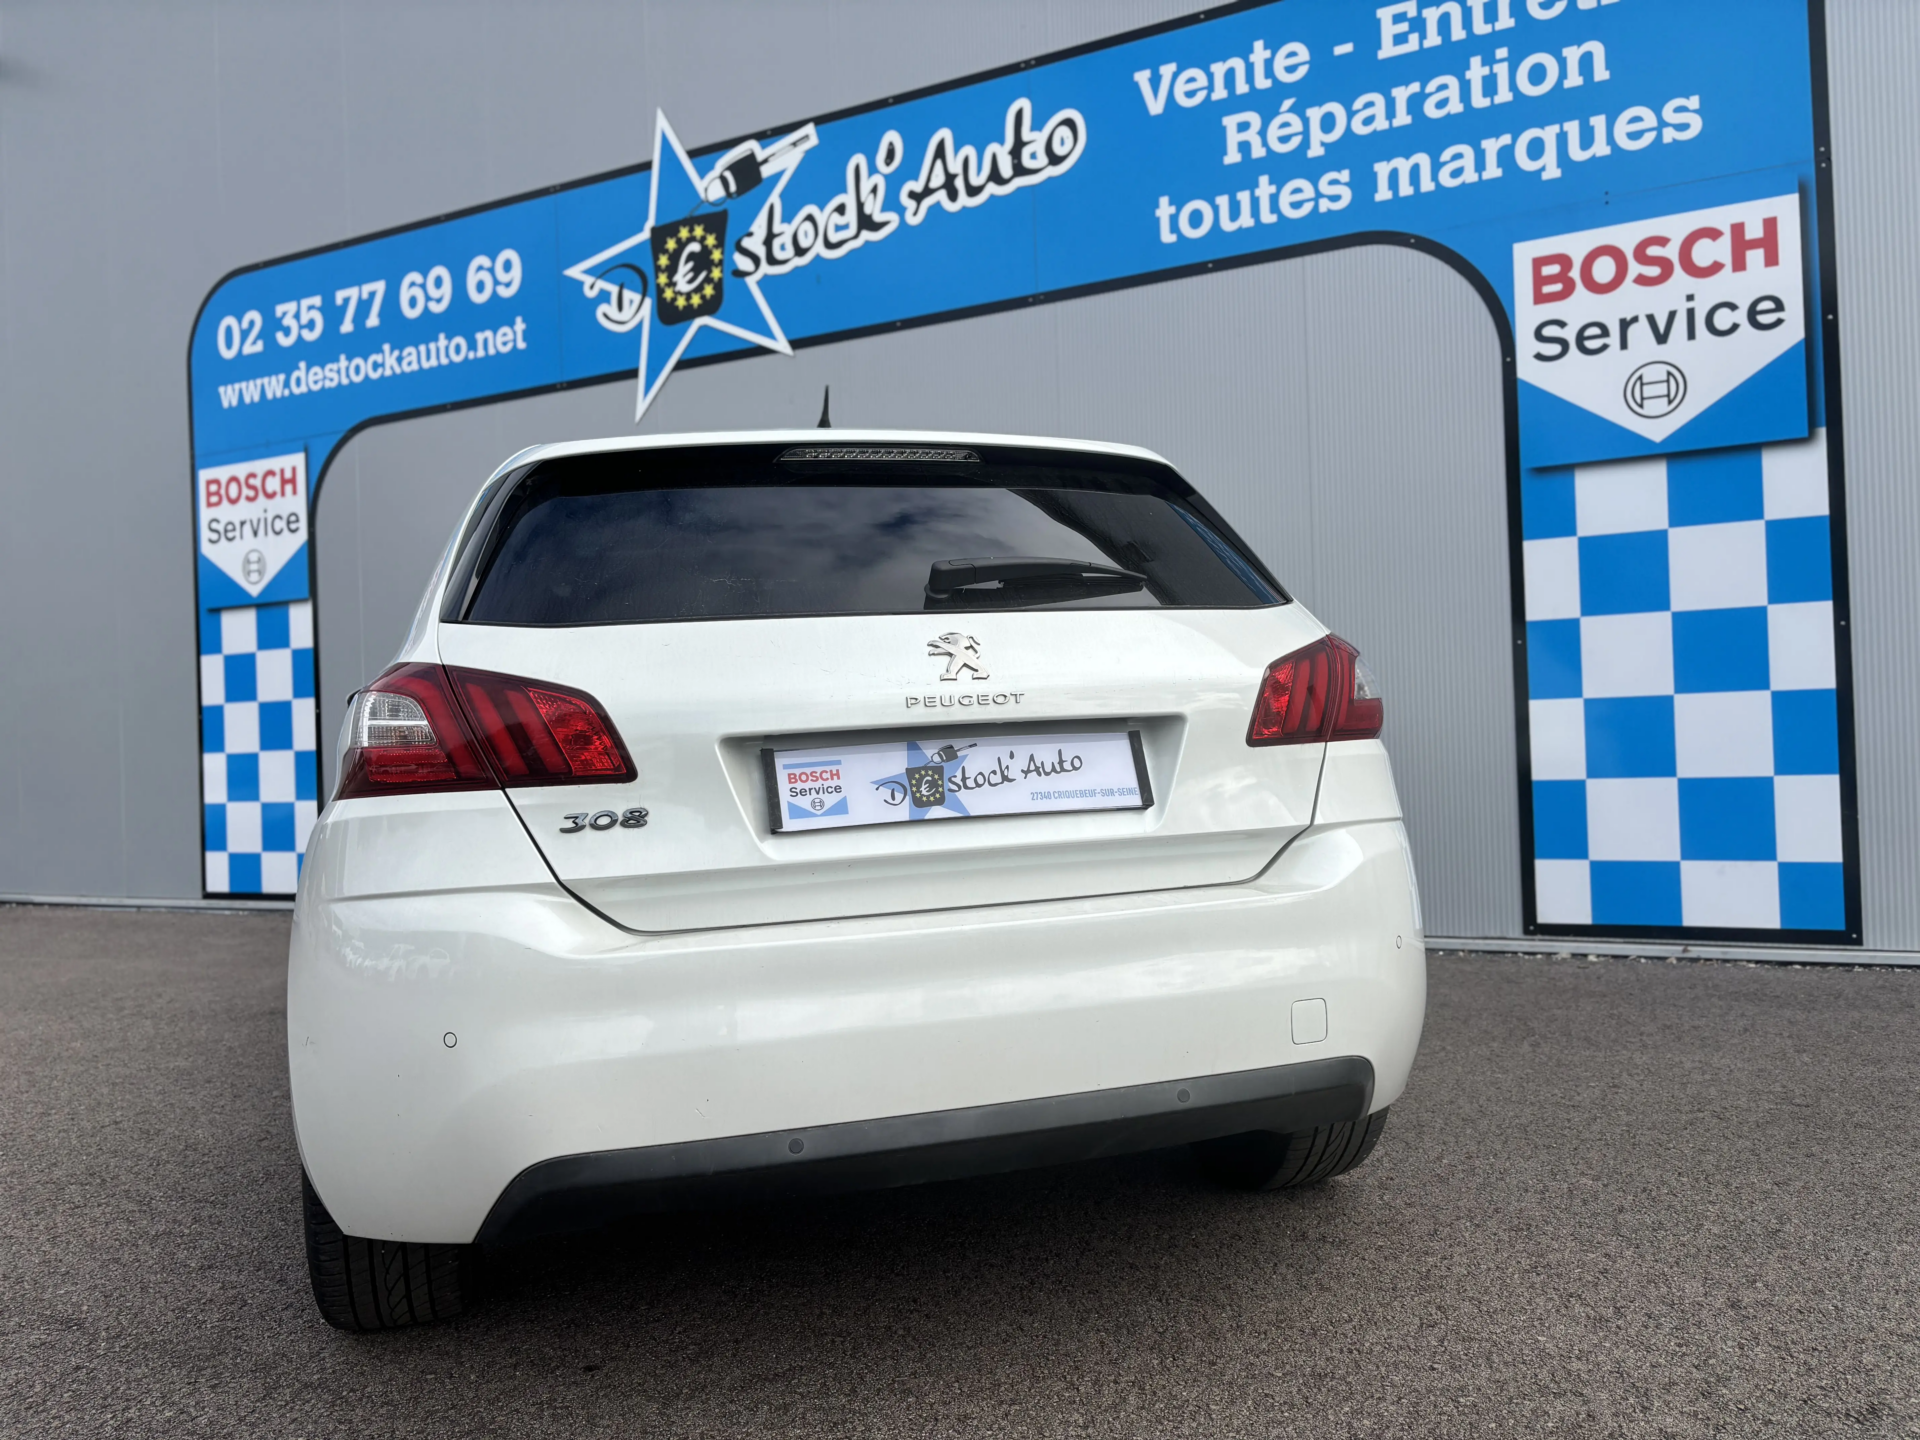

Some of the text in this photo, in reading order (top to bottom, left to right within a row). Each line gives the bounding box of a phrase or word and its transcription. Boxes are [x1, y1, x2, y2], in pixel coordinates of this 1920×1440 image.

[1133, 39, 1311, 116] Vente
[1376, 0, 1620, 60] Entr
[1221, 40, 1611, 166] Réparation
[1155, 94, 1703, 244] toutes marques
[1531, 216, 1780, 306] BOSCH
[217, 248, 523, 360] 02 35 77 69 69
[1532, 293, 1786, 363] Service
[218, 315, 527, 409] www.destockauto.net
[205, 466, 298, 509] BOSCH
[207, 508, 301, 545] Service
[905, 691, 1025, 708] PEUGEOT
[787, 769, 841, 785] BOSCH
[789, 783, 843, 798] Service
[1052, 786, 1139, 800] CRIQUEBEUF-SUR-SEINE
[559, 807, 649, 834] 308
